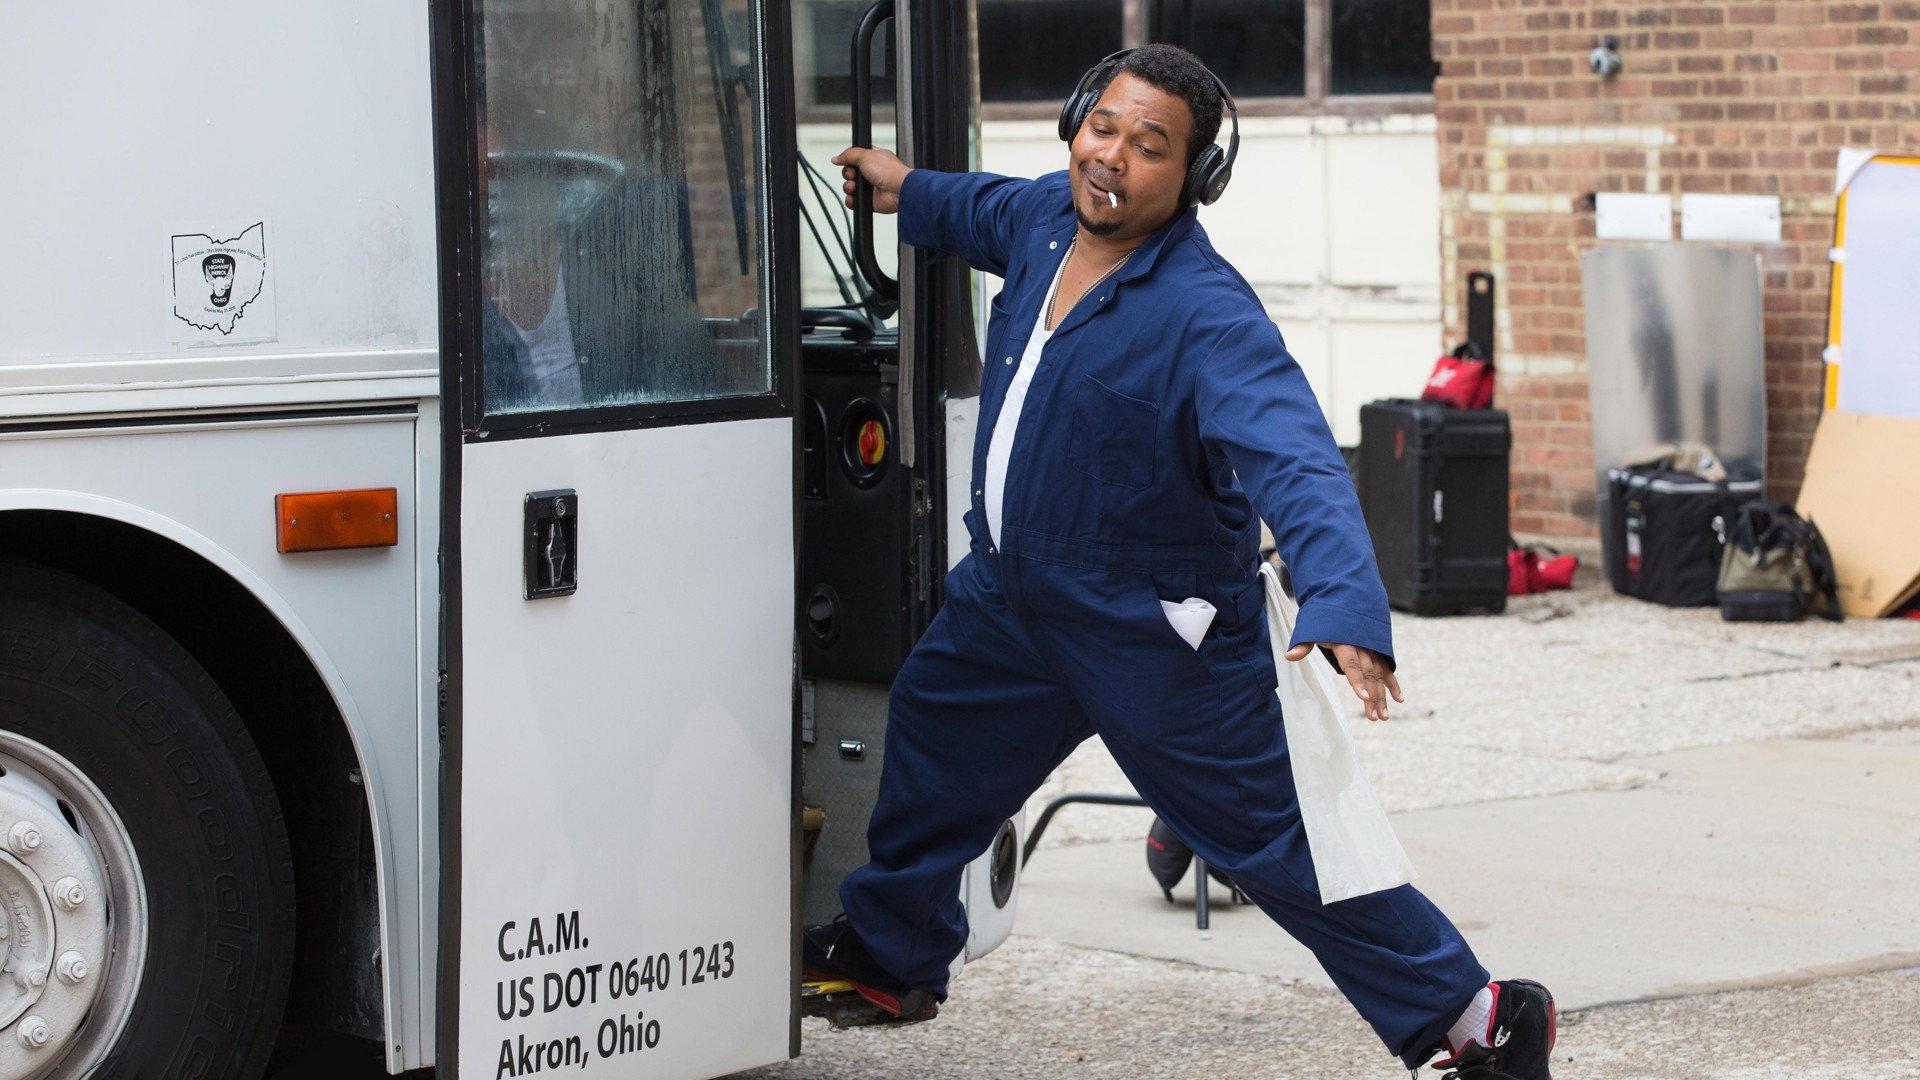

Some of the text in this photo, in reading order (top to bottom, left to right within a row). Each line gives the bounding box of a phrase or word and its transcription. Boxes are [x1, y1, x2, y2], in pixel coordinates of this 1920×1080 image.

[497, 910, 589, 962] C.A.M.
[497, 941, 735, 1021] US DOT 0640 1243
[496, 1011, 661, 1080] Akron, Ohio
